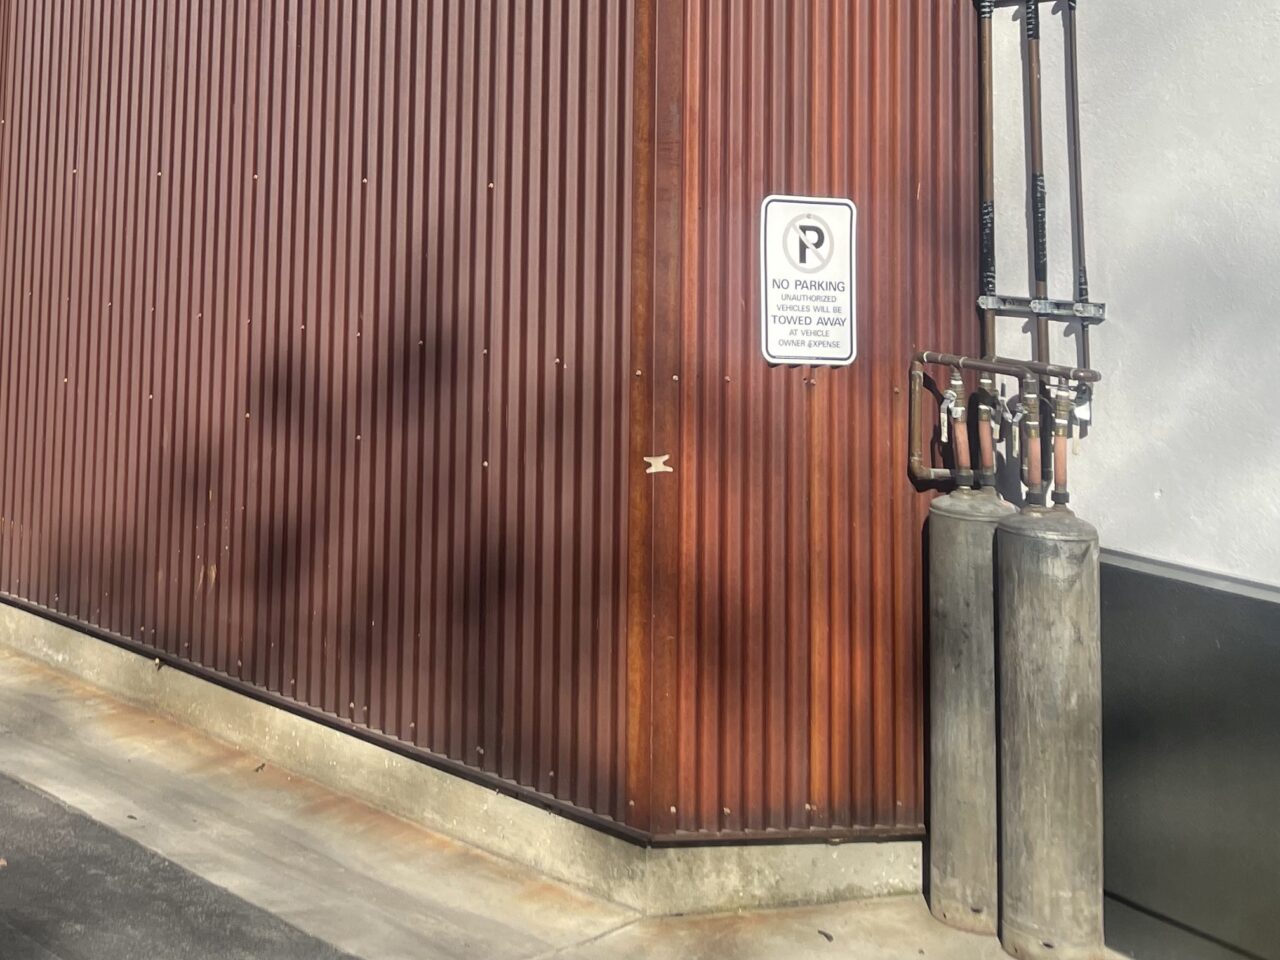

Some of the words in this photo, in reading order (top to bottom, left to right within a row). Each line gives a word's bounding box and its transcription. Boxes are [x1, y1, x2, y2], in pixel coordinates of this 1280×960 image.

[772, 278, 790, 290] NO
[794, 279, 846, 292] PARKING
[781, 293, 837, 303] UNAUTHORIZED
[776, 304, 811, 312] VEHICLES
[813, 305, 830, 313] WILL
[832, 306, 842, 314] BE
[771, 314, 812, 326] TOWED
[816, 316, 847, 327] AWAY
[801, 329, 830, 337] VEHICLE
[778, 339, 805, 347] OWNER
[807, 340, 841, 348] EXPENSE
